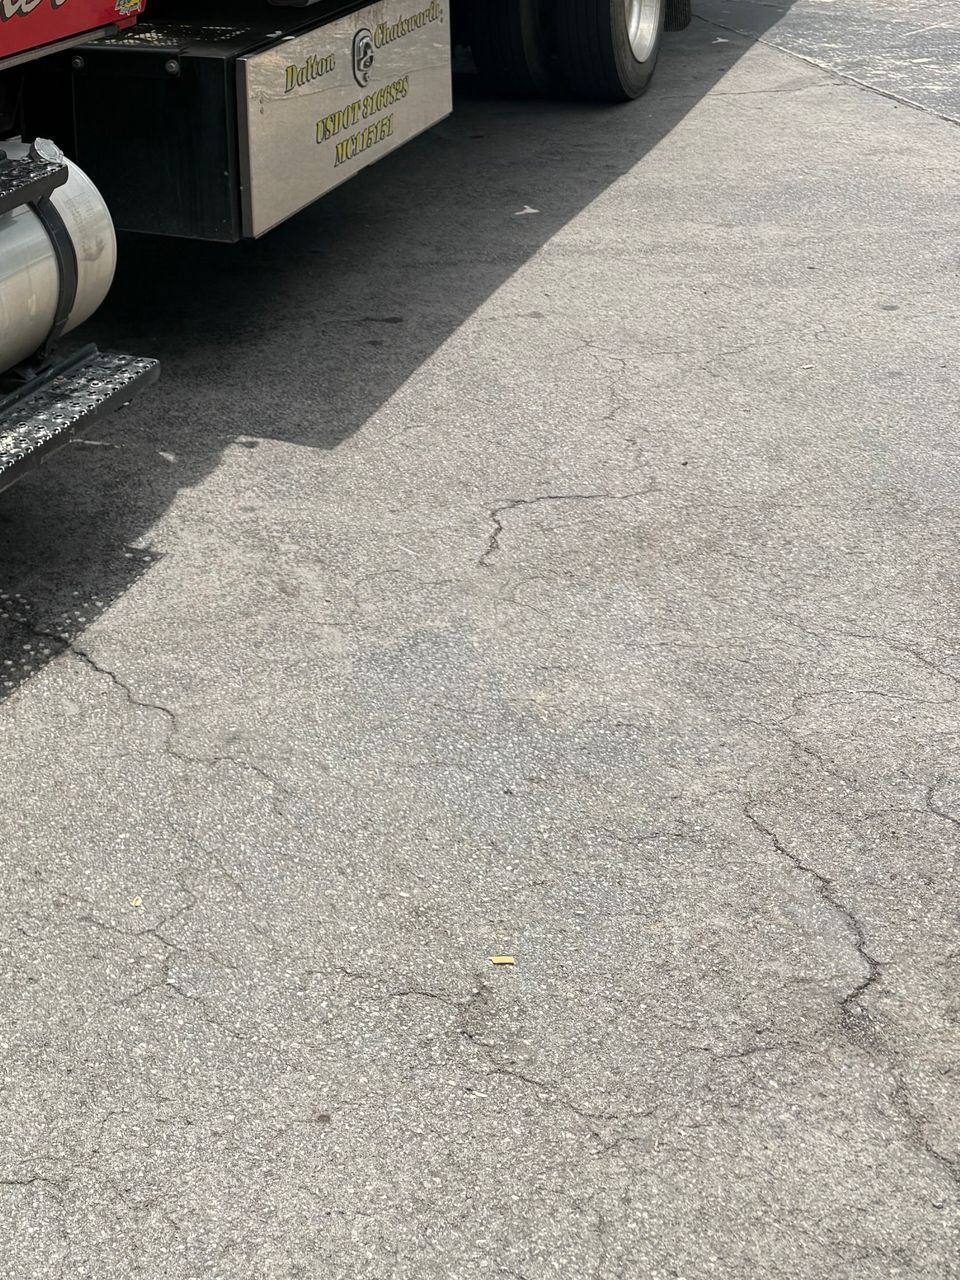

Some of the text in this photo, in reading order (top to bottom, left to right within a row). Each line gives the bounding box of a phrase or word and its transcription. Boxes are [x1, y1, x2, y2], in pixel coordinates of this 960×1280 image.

[284, 52, 336, 93] Dalton
[315, 97, 361, 145] USDOT
[334, 113, 394, 168] MC115151
